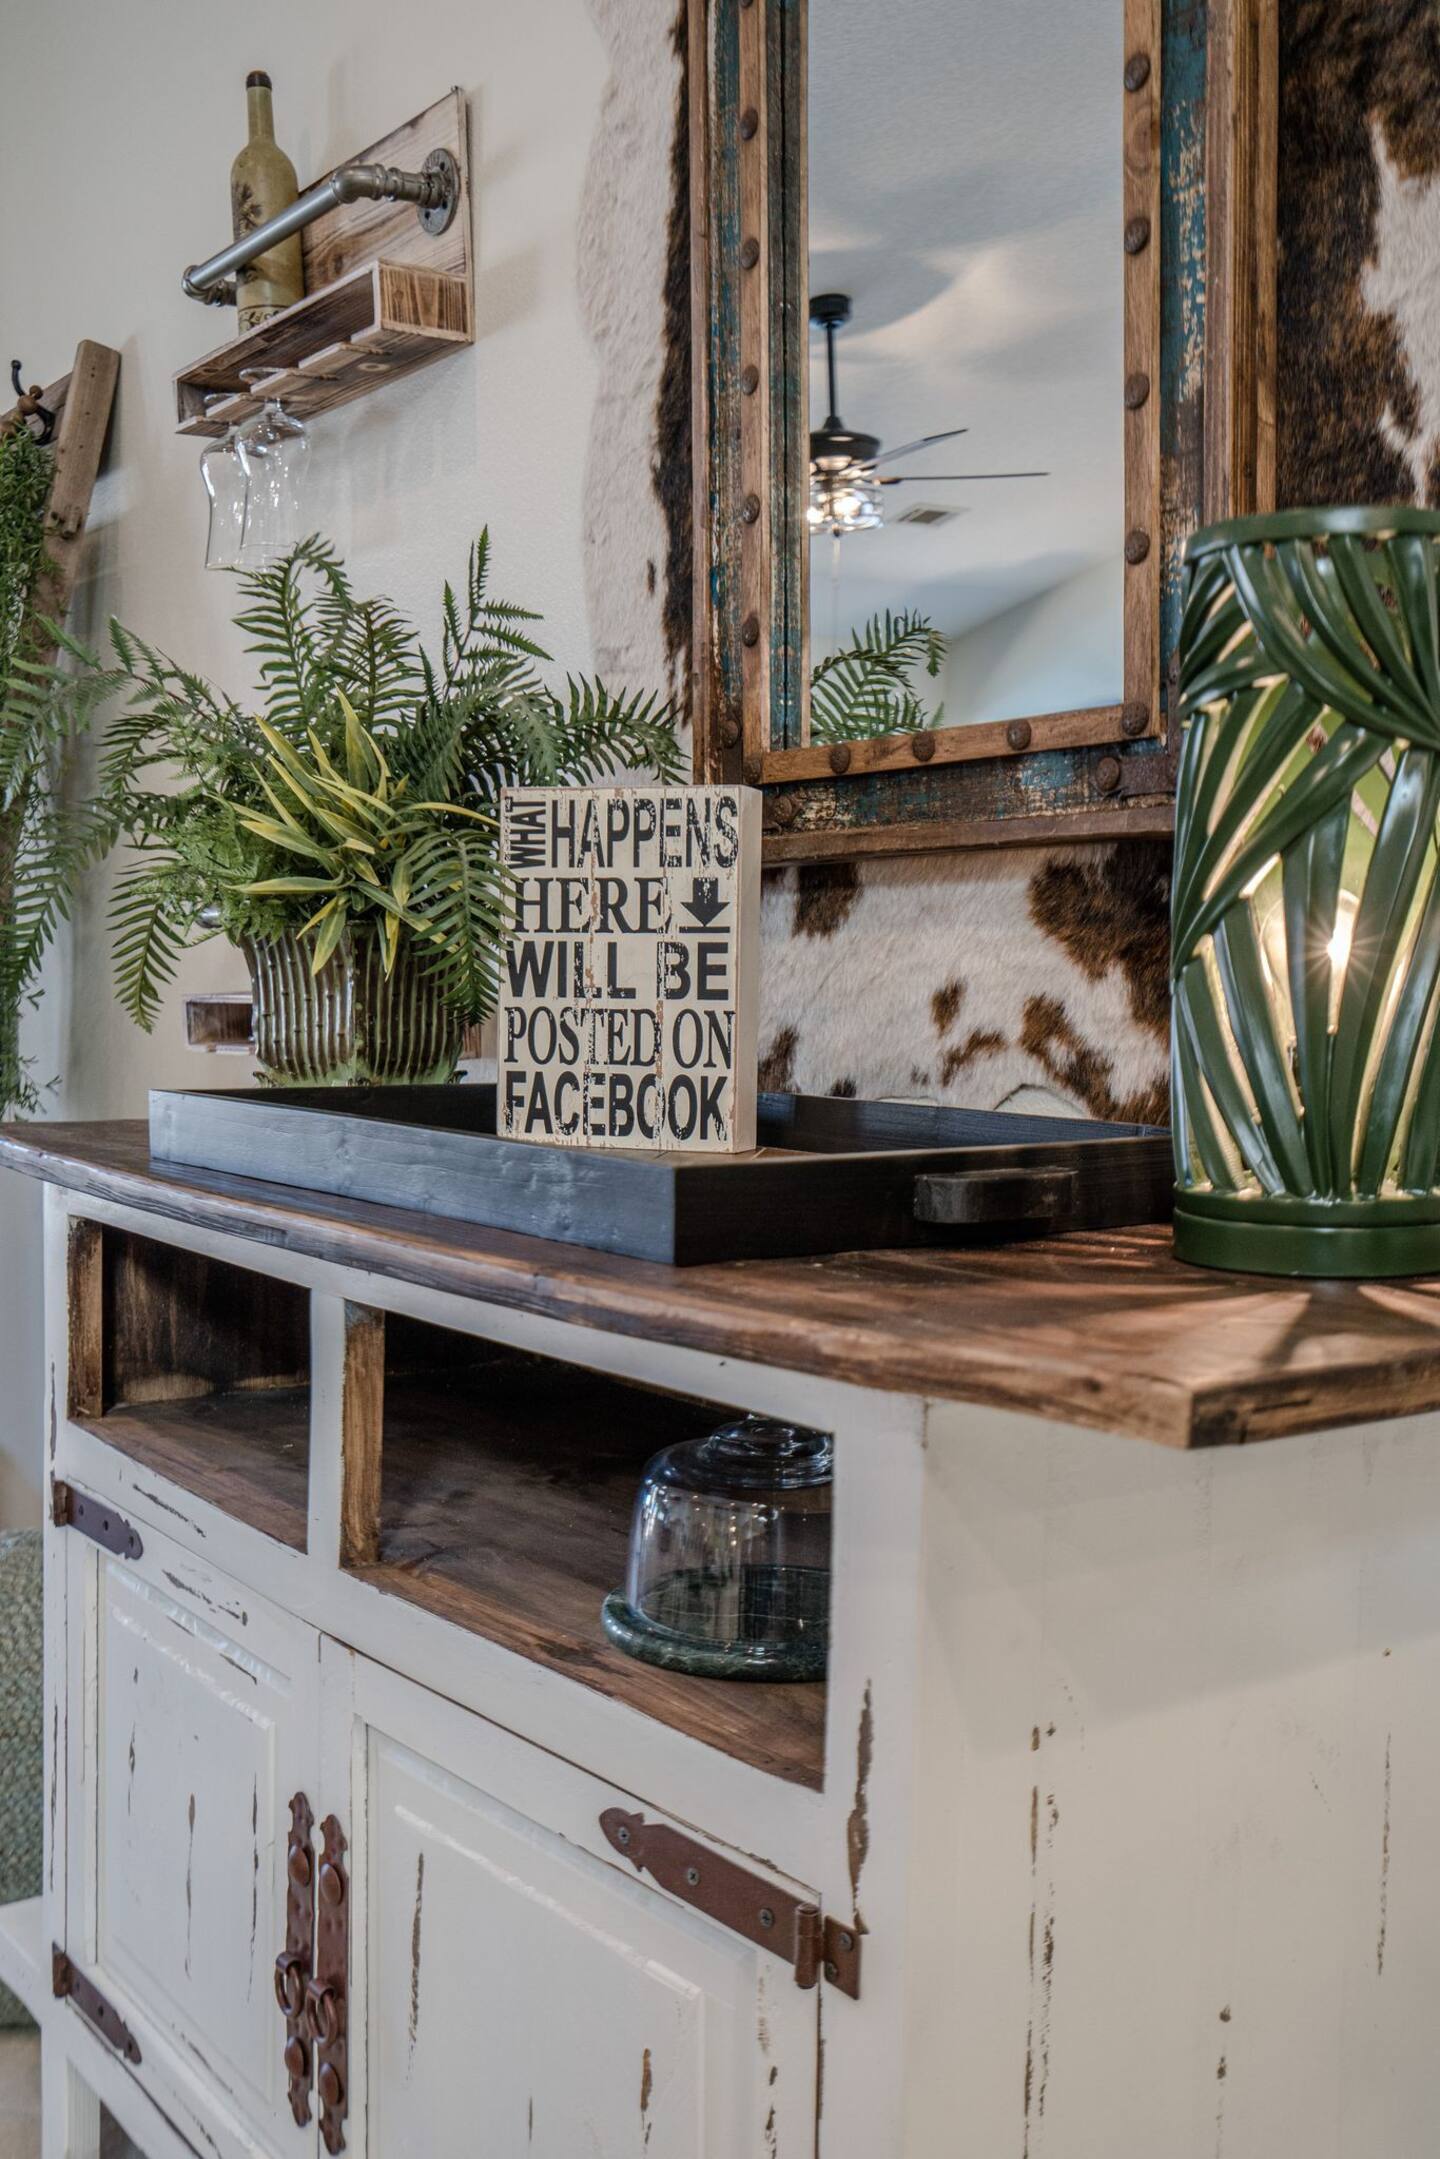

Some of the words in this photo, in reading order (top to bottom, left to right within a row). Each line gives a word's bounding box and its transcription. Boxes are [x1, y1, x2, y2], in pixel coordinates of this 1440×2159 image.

[505, 796, 547, 870] WHAT
[551, 797, 738, 868] HAPPENS
[509, 877, 672, 934] HERE
[506, 941, 636, 999] WILL
[656, 941, 729, 1001] BE
[504, 1006, 662, 1067] POSTED
[672, 1008, 736, 1070] ON
[504, 1070, 729, 1141] FACEBOOK
